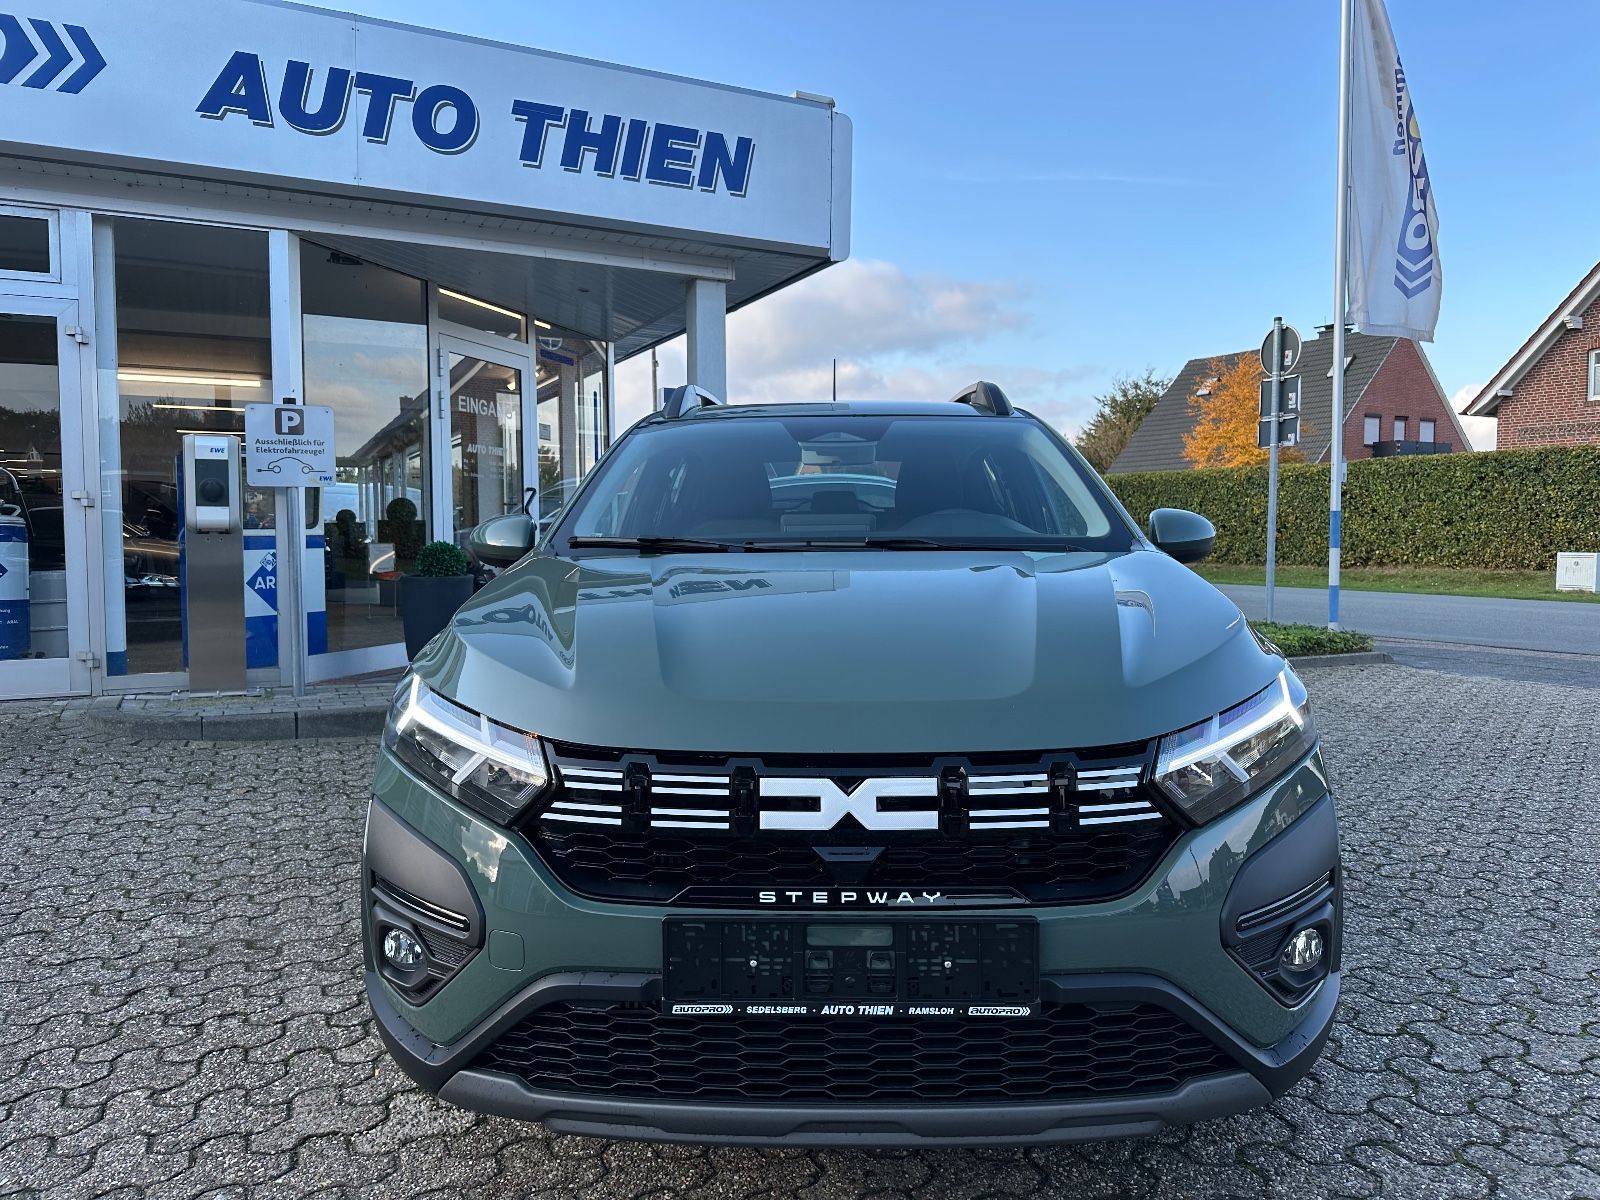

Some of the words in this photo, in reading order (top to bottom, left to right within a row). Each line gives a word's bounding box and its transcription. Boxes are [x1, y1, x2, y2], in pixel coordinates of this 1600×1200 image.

[196, 50, 479, 156] AUTO
[512, 99, 756, 197] THIEN
[281, 410, 301, 433] P
[255, 438, 312, 447] Ausschließlich
[255, 447, 325, 457] Elektrofahrzeuge!
[467, 444, 486, 454] AUTO
[759, 891, 941, 904] STEPWAY
[746, 1006, 807, 1015] SEDELSBERG
[820, 1005, 855, 1015] AUTO
[857, 1005, 894, 1015] THIEN
[908, 1007, 955, 1015] RAMSLOH
